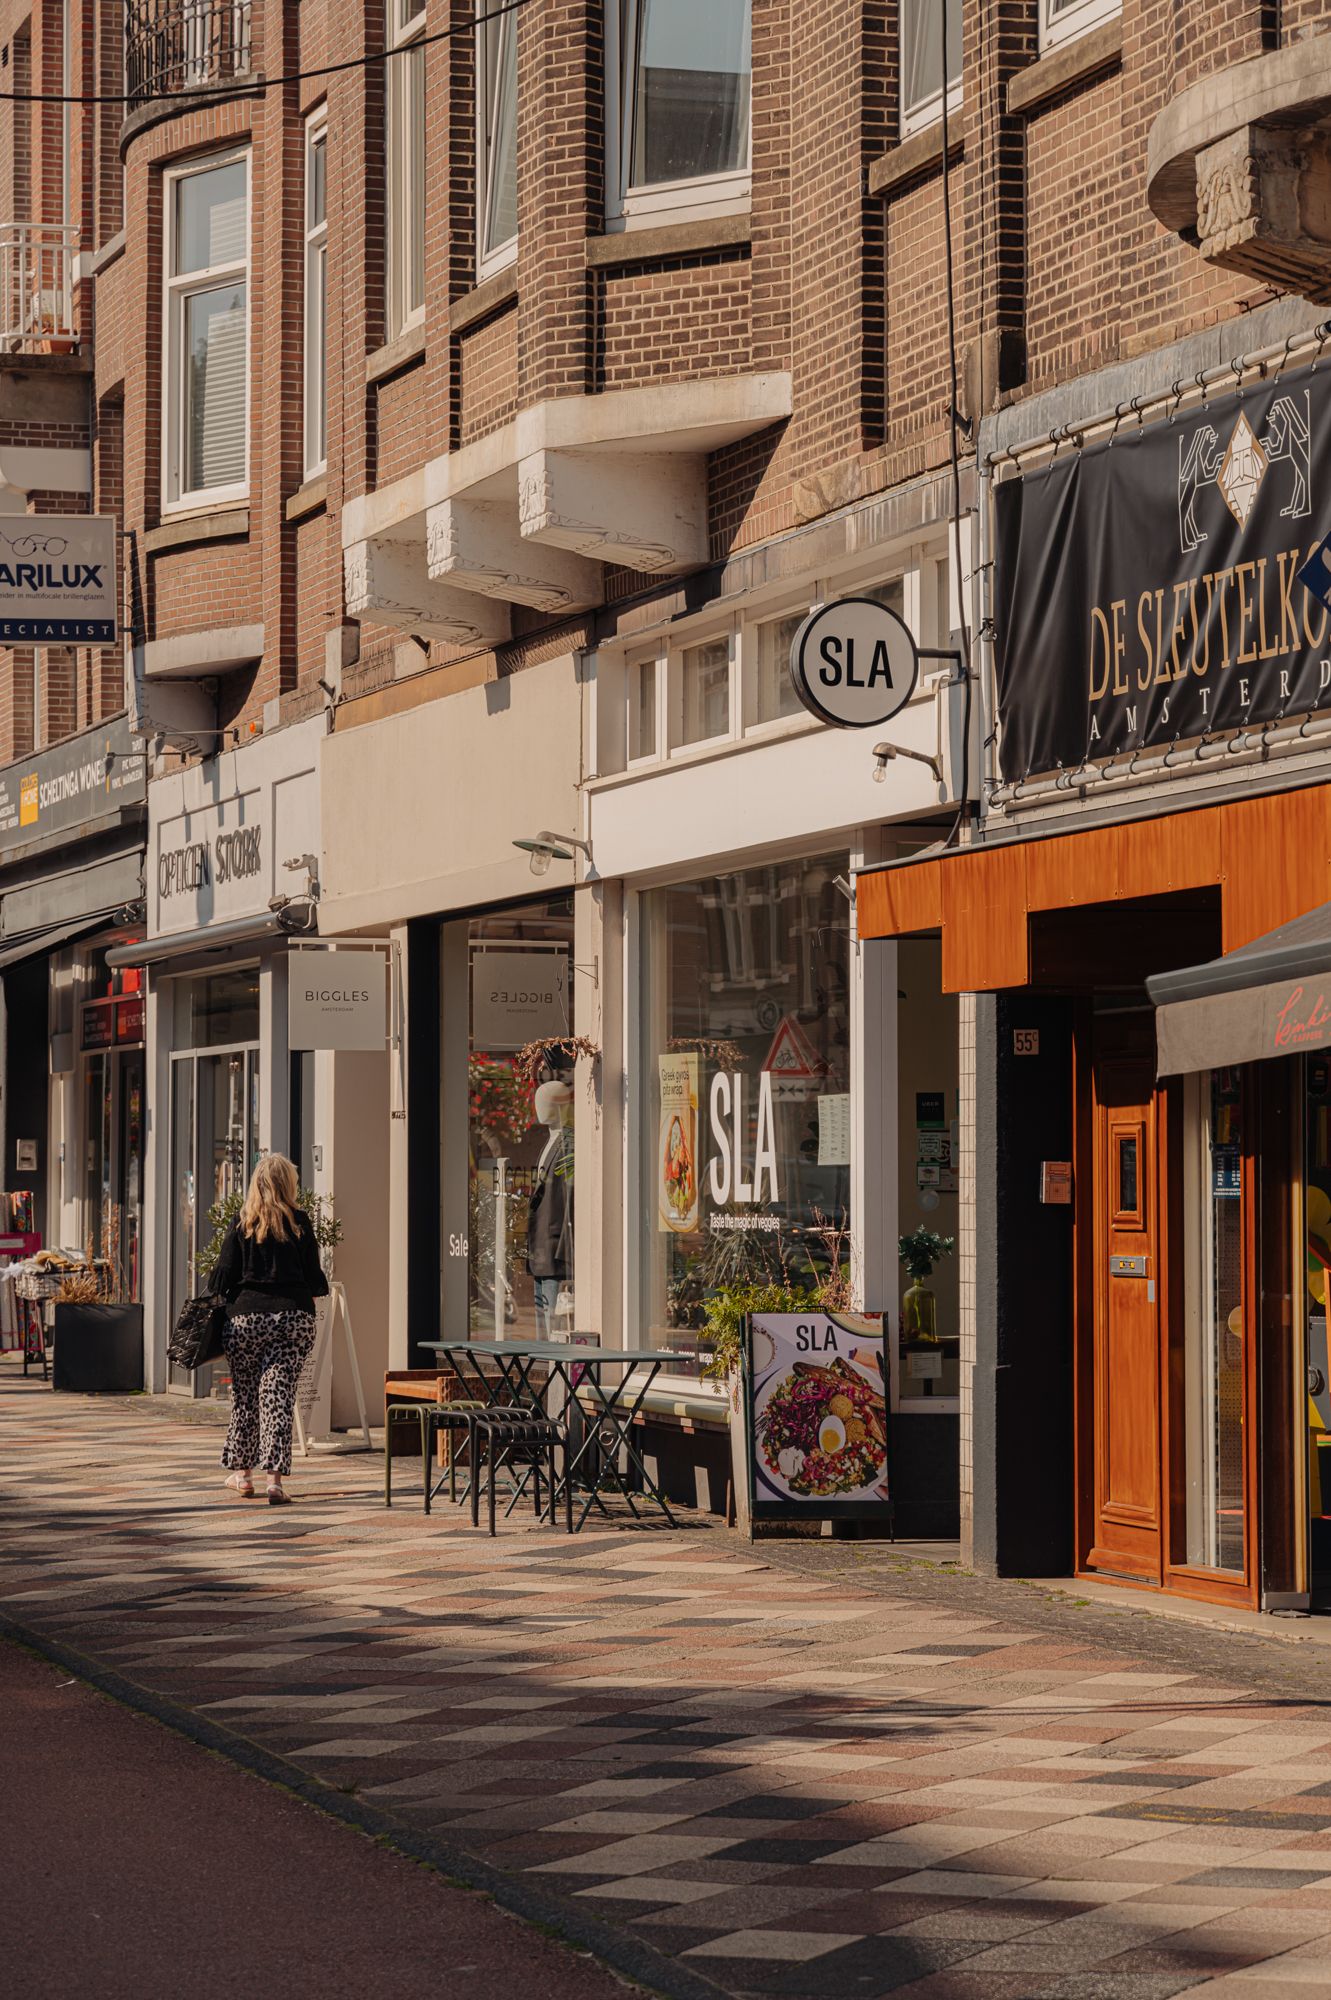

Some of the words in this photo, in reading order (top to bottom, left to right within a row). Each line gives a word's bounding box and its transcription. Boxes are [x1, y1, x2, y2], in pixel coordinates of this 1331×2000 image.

[18, 592, 24, 600] in
[1089, 600, 1129, 701] DE
[1138, 541, 1331, 692] SLEUTELKO
[819, 636, 894, 689] SLA
[40, 769, 79, 810] SCHELTINGA
[160, 840, 211, 899] OPTICIEN
[215, 825, 261, 884] STORK
[305, 991, 369, 1001] BIGGLES
[710, 1071, 778, 1205] SLA
[709, 1212, 725, 1229] Taste
[725, 1213, 734, 1229] the
[735, 1213, 751, 1231] magic
[758, 1213, 780, 1232] veggies
[450, 1234, 469, 1257] Sale
[796, 1325, 838, 1351] SLA
